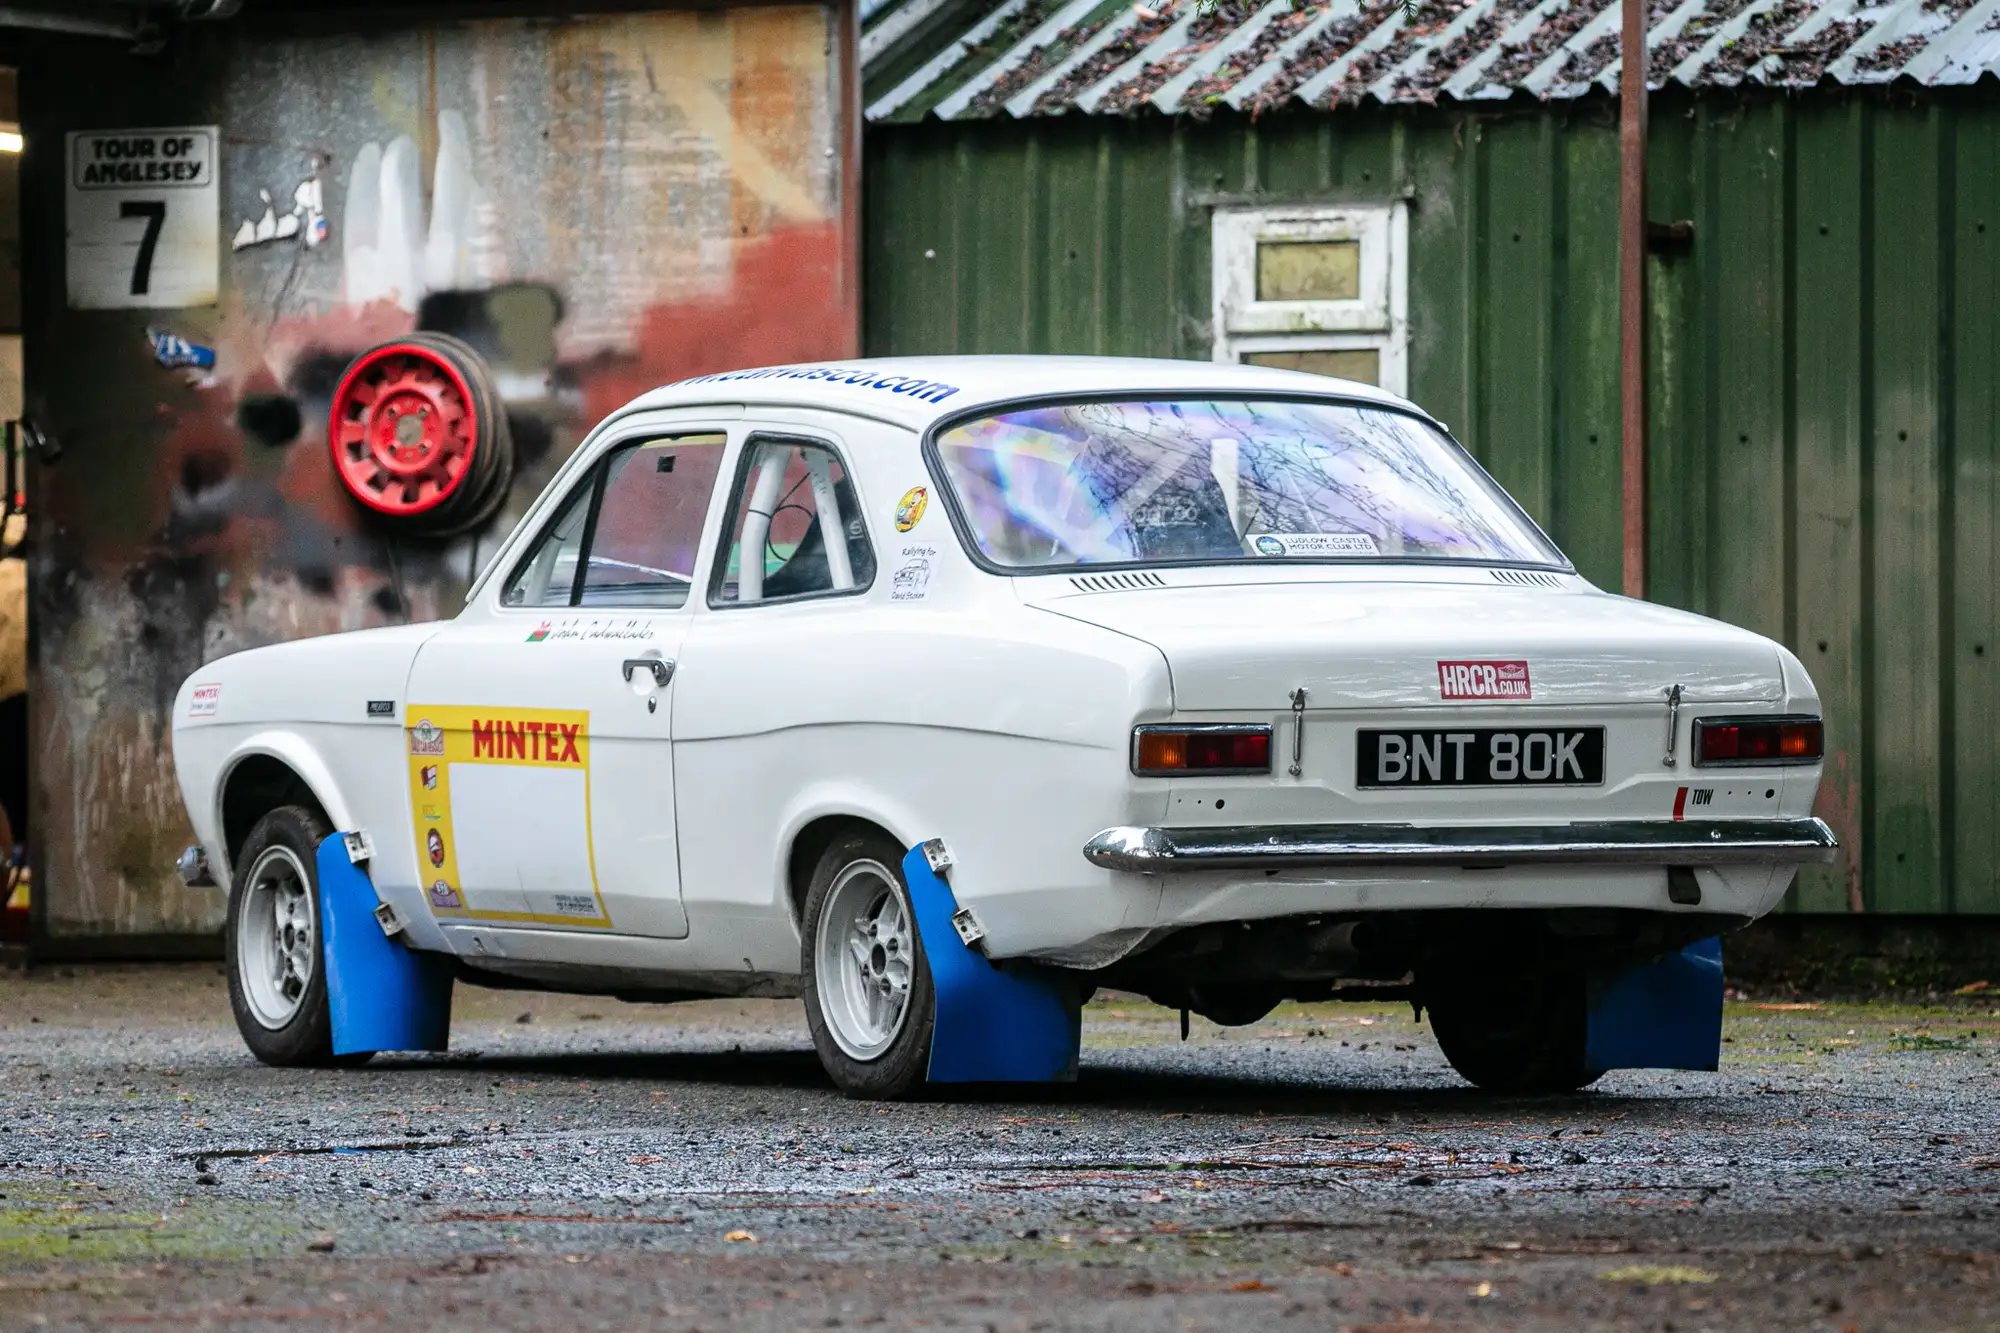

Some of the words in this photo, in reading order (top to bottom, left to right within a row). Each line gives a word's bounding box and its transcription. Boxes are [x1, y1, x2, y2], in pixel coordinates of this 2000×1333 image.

[92, 138, 155, 160] TOUR
[162, 137, 194, 157] OF
[83, 161, 202, 183] ANGLESEY
[119, 201, 166, 296] 7
[901, 546, 927, 557] Rallying
[472, 718, 581, 764] MINTEX
[1377, 733, 1475, 781] BNT
[1489, 732, 1585, 780] 80K
[1691, 788, 1715, 805] TOW
